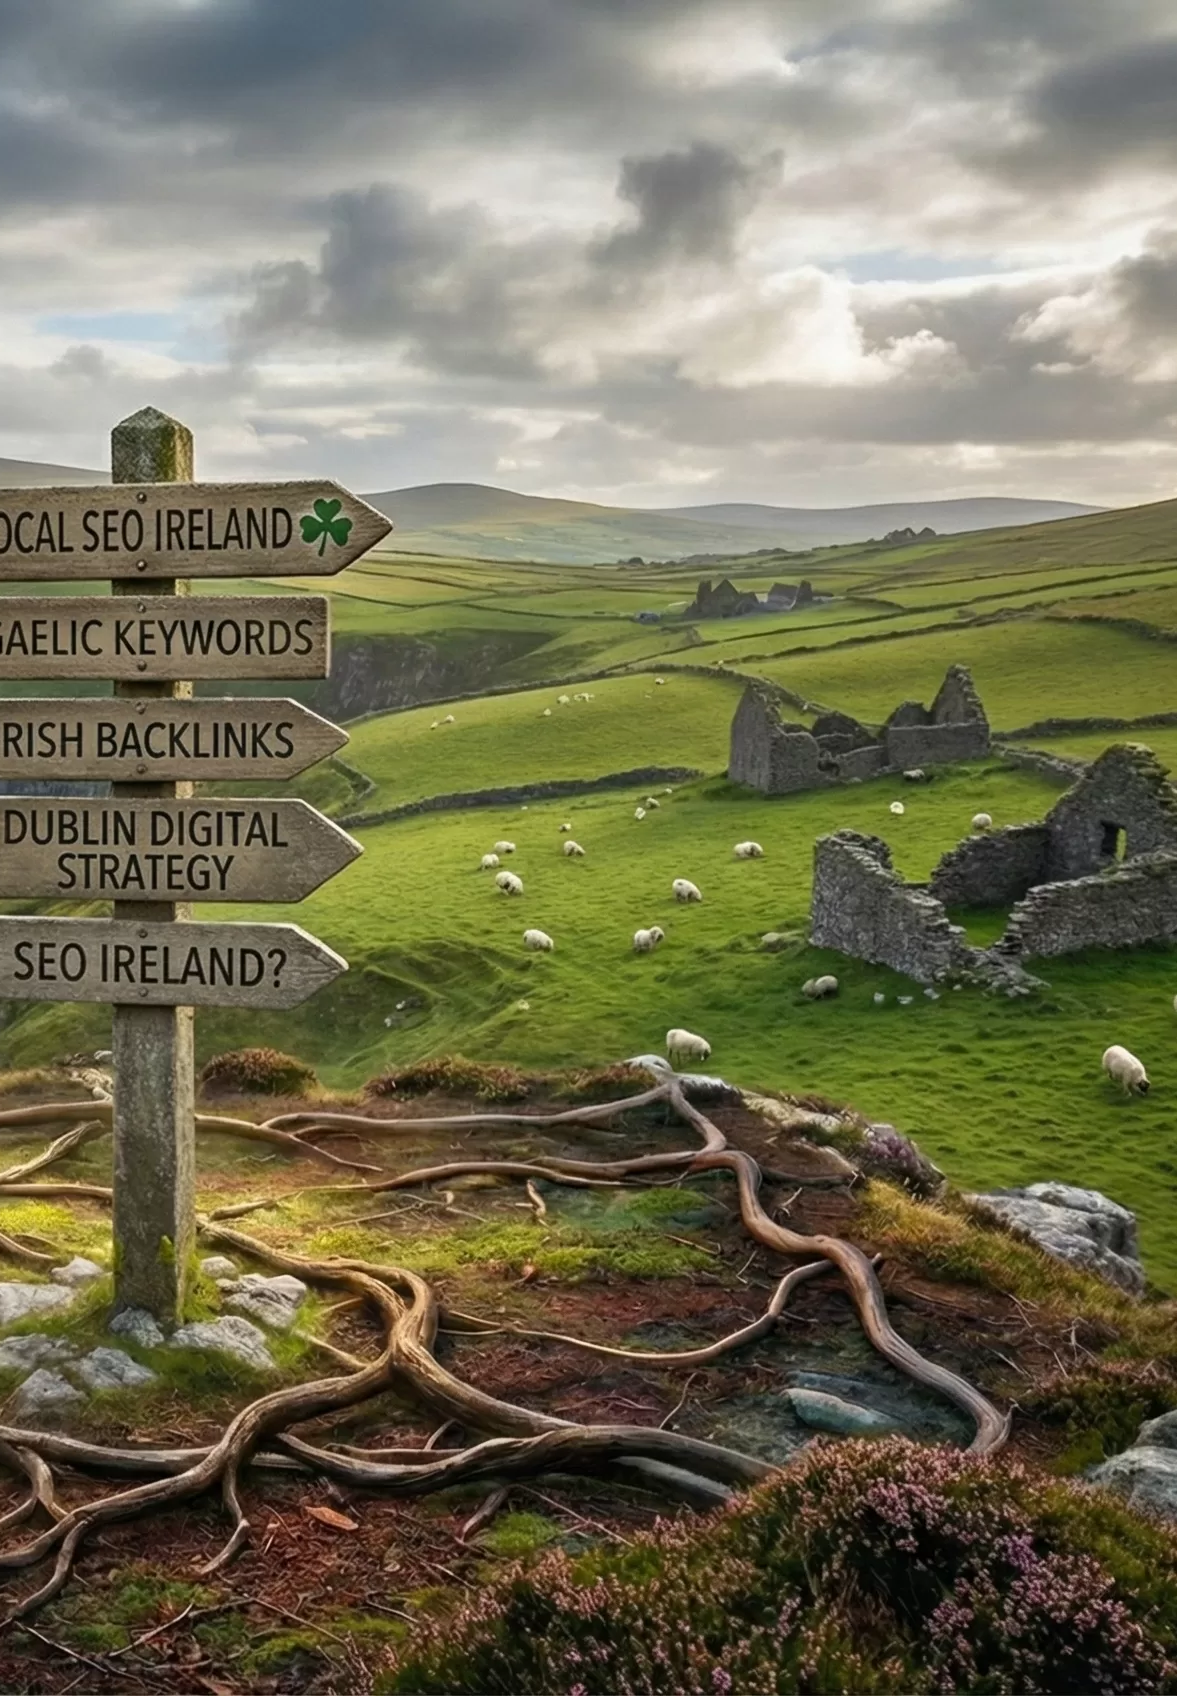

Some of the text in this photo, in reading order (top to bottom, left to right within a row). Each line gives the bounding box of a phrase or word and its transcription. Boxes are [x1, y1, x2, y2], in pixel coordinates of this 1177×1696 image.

[82, 509, 143, 552] SEO
[155, 507, 293, 551] IRELAND
[114, 619, 313, 656] KEYWORDS
[96, 721, 295, 758] BACKLINKS
[4, 809, 288, 848] DUBLIN DIGITAL
[57, 853, 234, 891] STRATEGY
[13, 941, 287, 988] SEO IRELAND?
